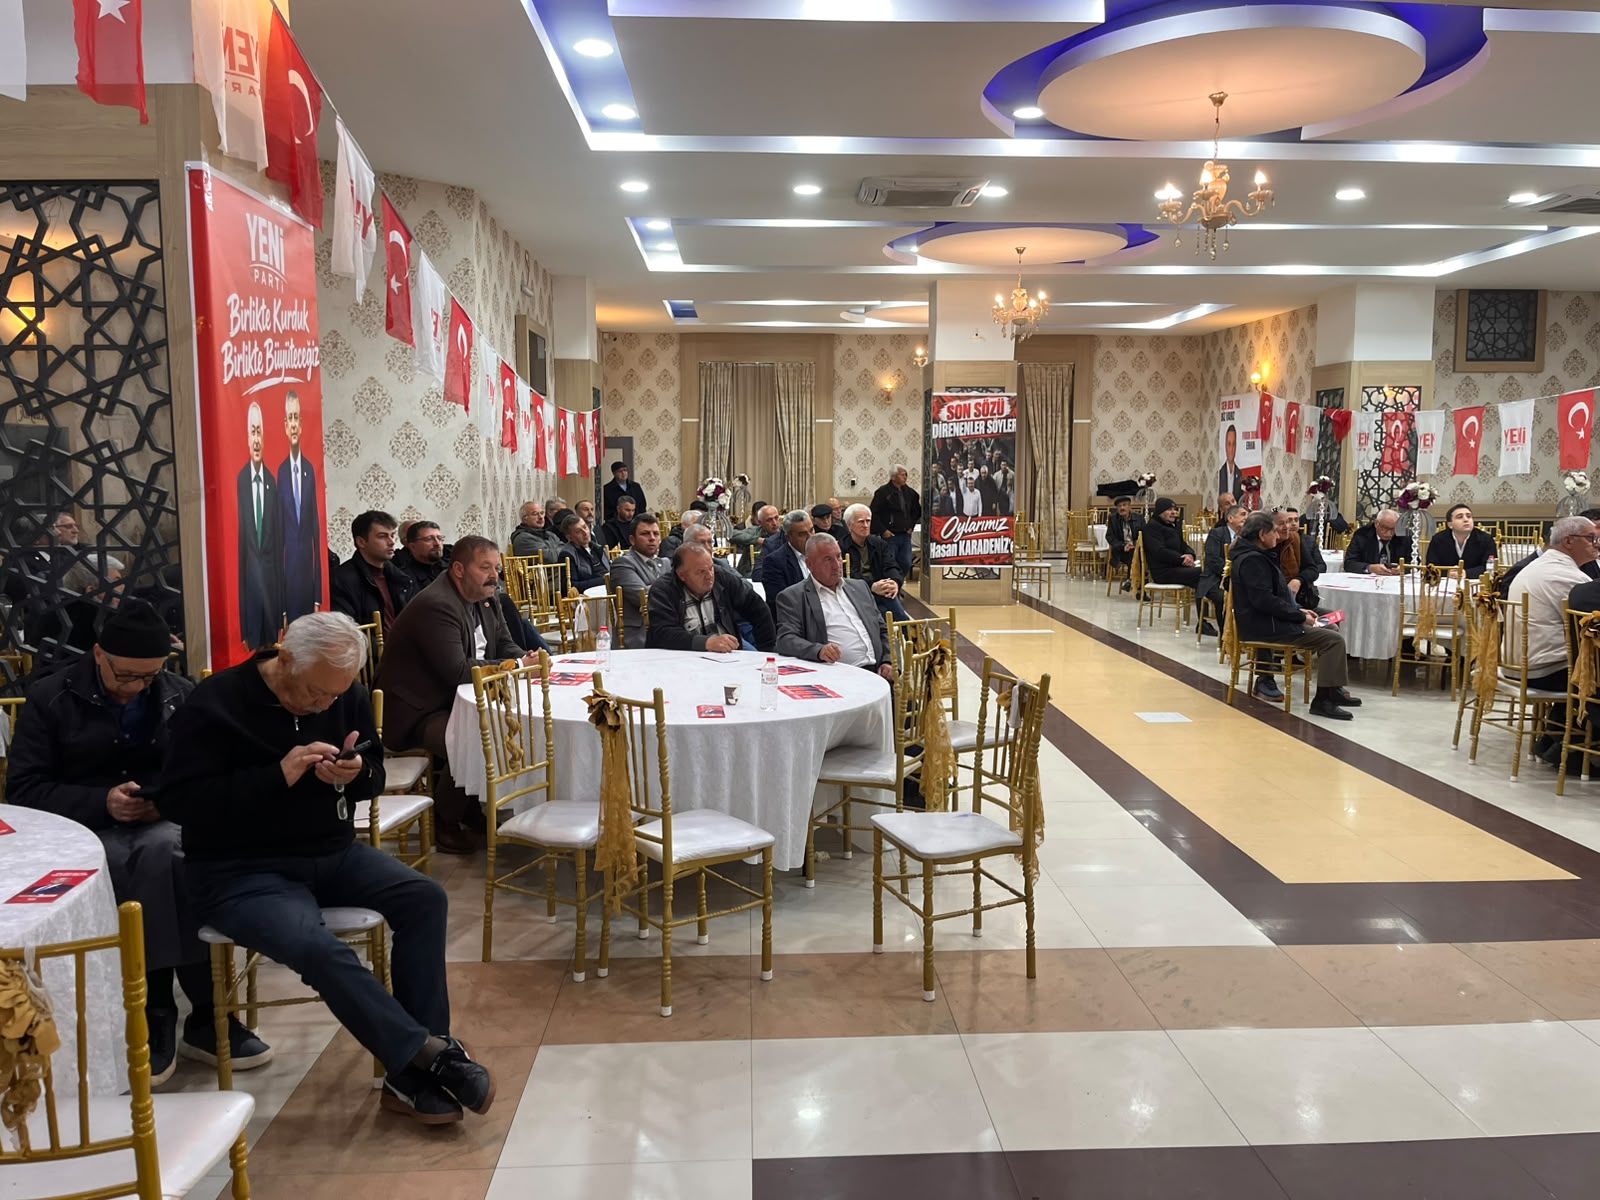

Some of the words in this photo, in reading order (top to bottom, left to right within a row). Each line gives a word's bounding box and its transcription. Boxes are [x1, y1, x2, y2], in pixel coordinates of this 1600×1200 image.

[227, 293, 271, 337] Birlikte
[273, 297, 310, 333] Kurduk
[221, 340, 264, 384] Birlikte
[264, 338, 320, 381] Büyüteceğiz
[946, 403, 971, 421] SON
[974, 398, 1005, 418] SÖZÜ
[932, 421, 985, 438] DİRENENLER
[941, 516, 1009, 542] Oylarımız
[930, 542, 957, 558] Hasan
